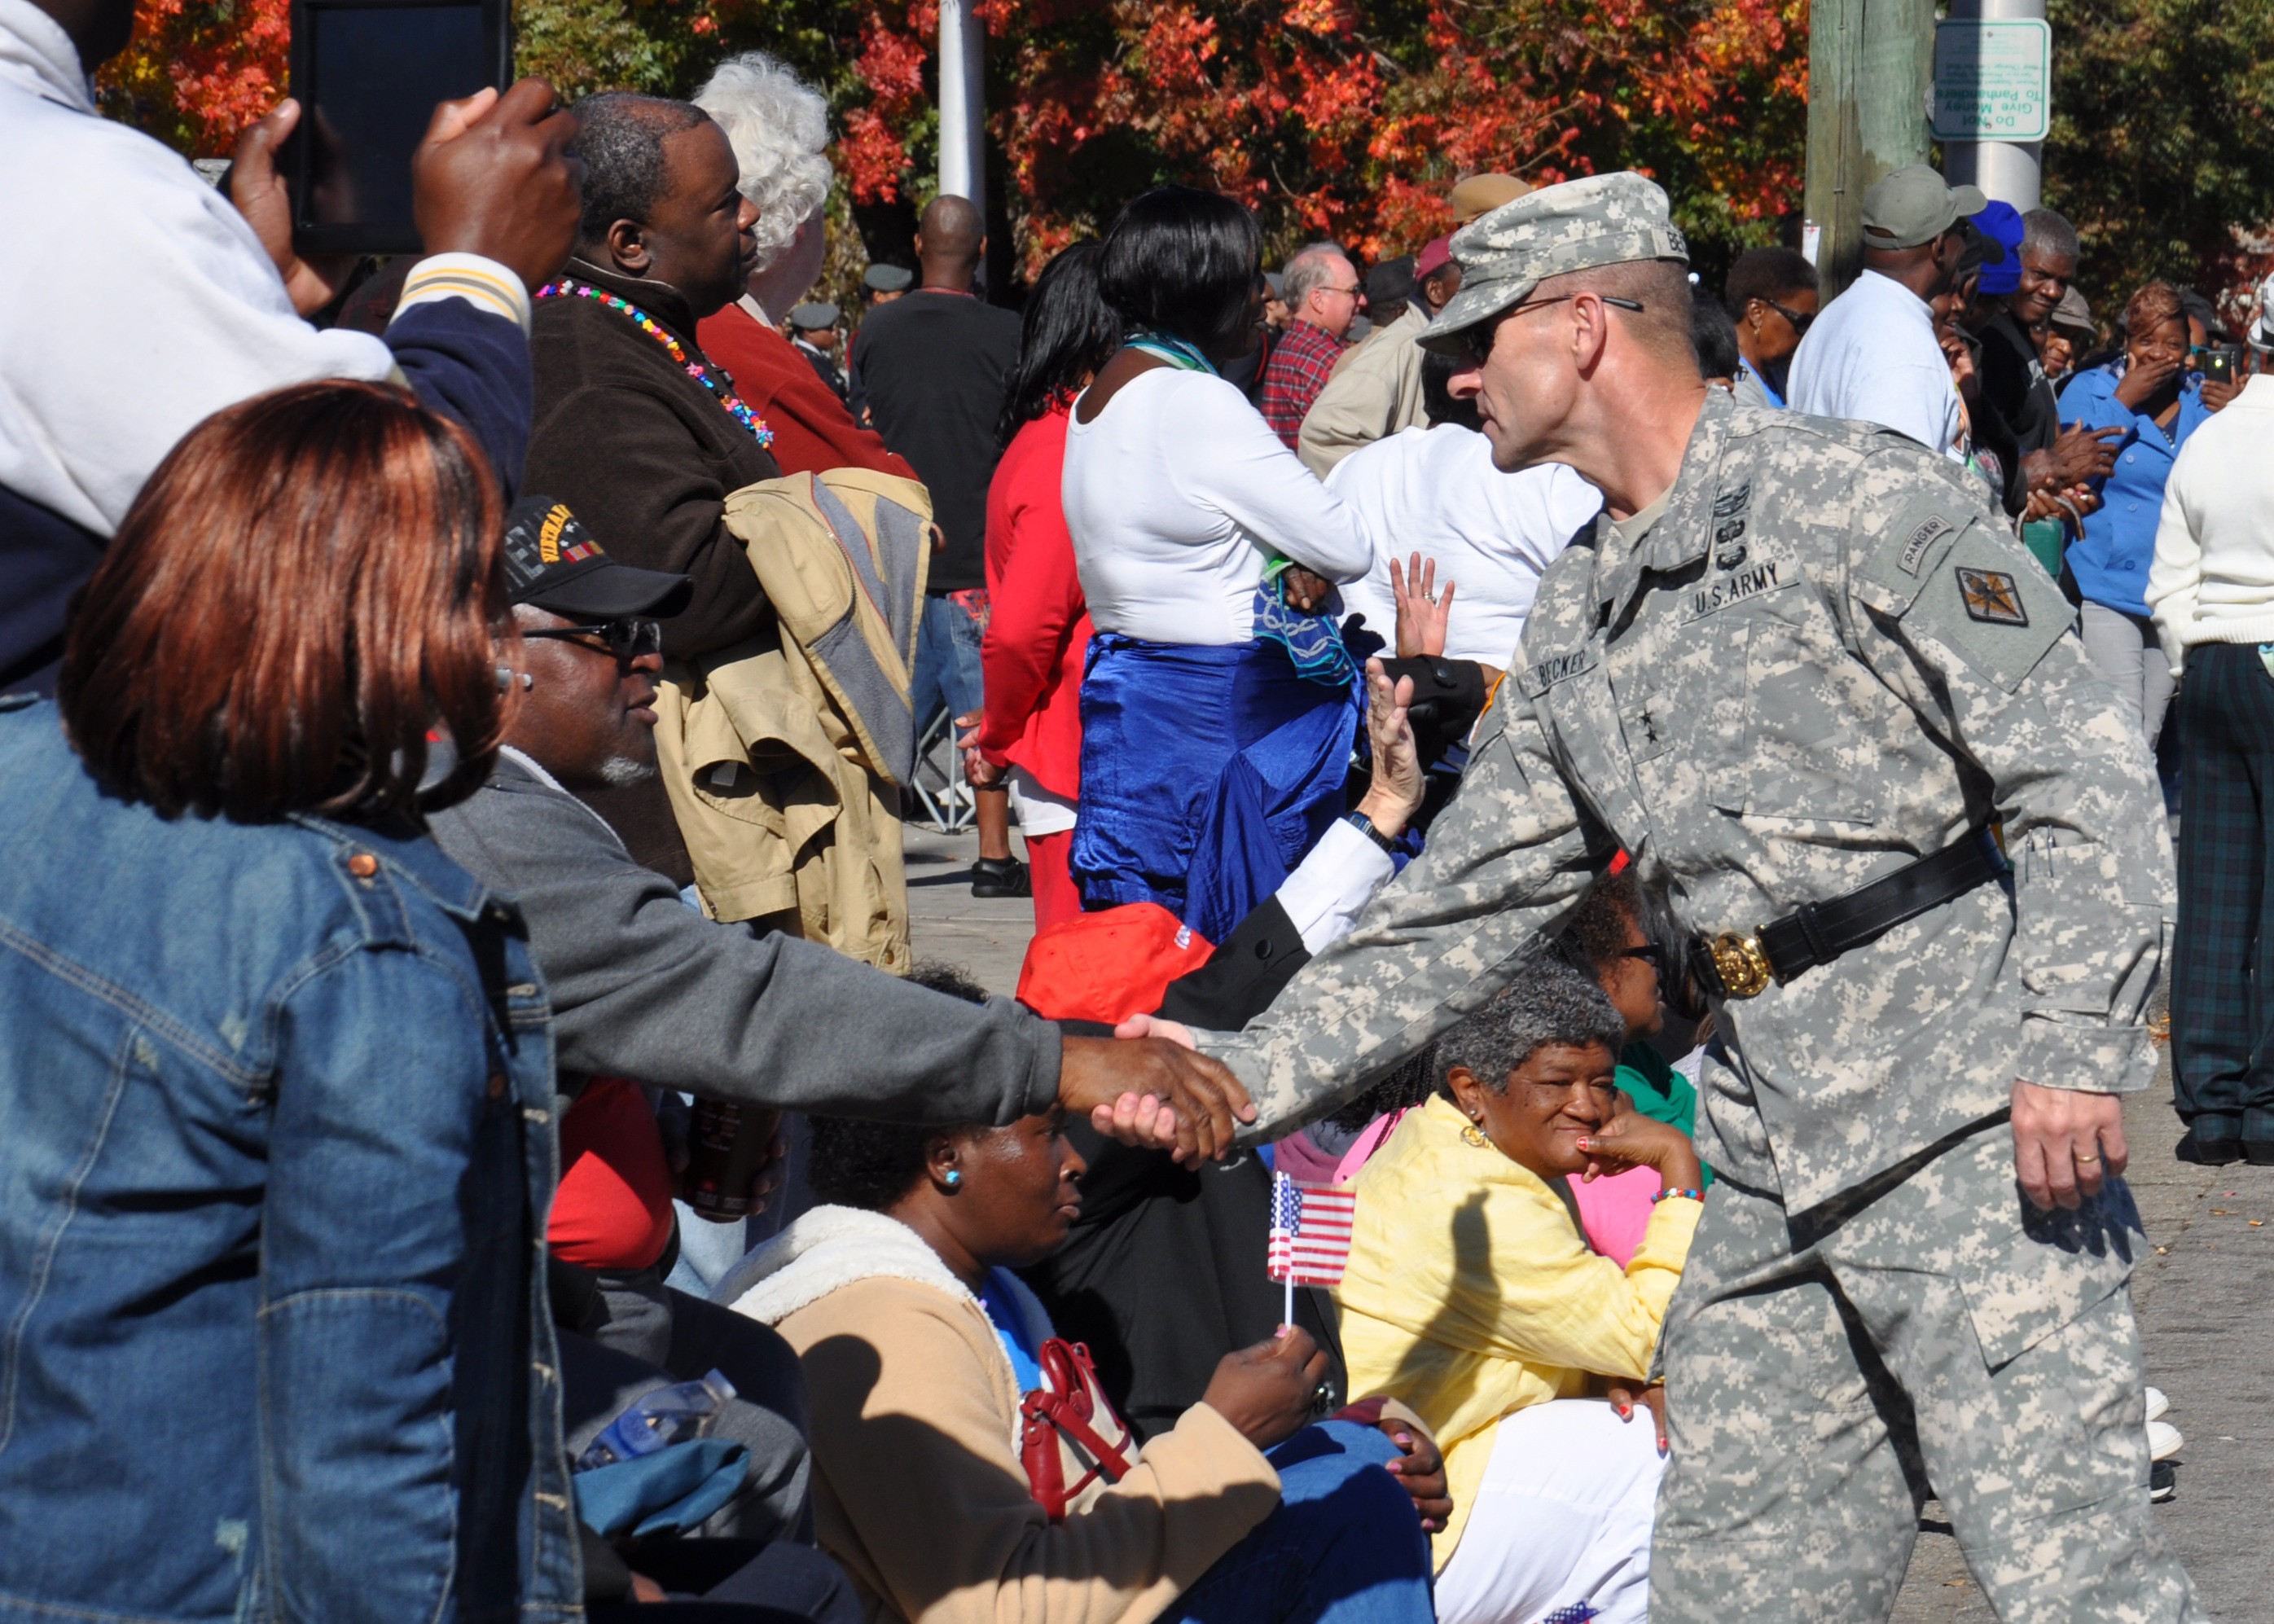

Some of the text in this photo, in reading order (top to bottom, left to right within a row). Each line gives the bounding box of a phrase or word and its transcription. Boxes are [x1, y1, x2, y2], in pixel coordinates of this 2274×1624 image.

[1935, 90, 2042, 102] To Panhandlers
[1945, 101, 2033, 114] Give Money
[1963, 116, 2014, 126] Do Not
[1904, 520, 1941, 564] RANGER
[1538, 650, 1587, 688] BECKER
